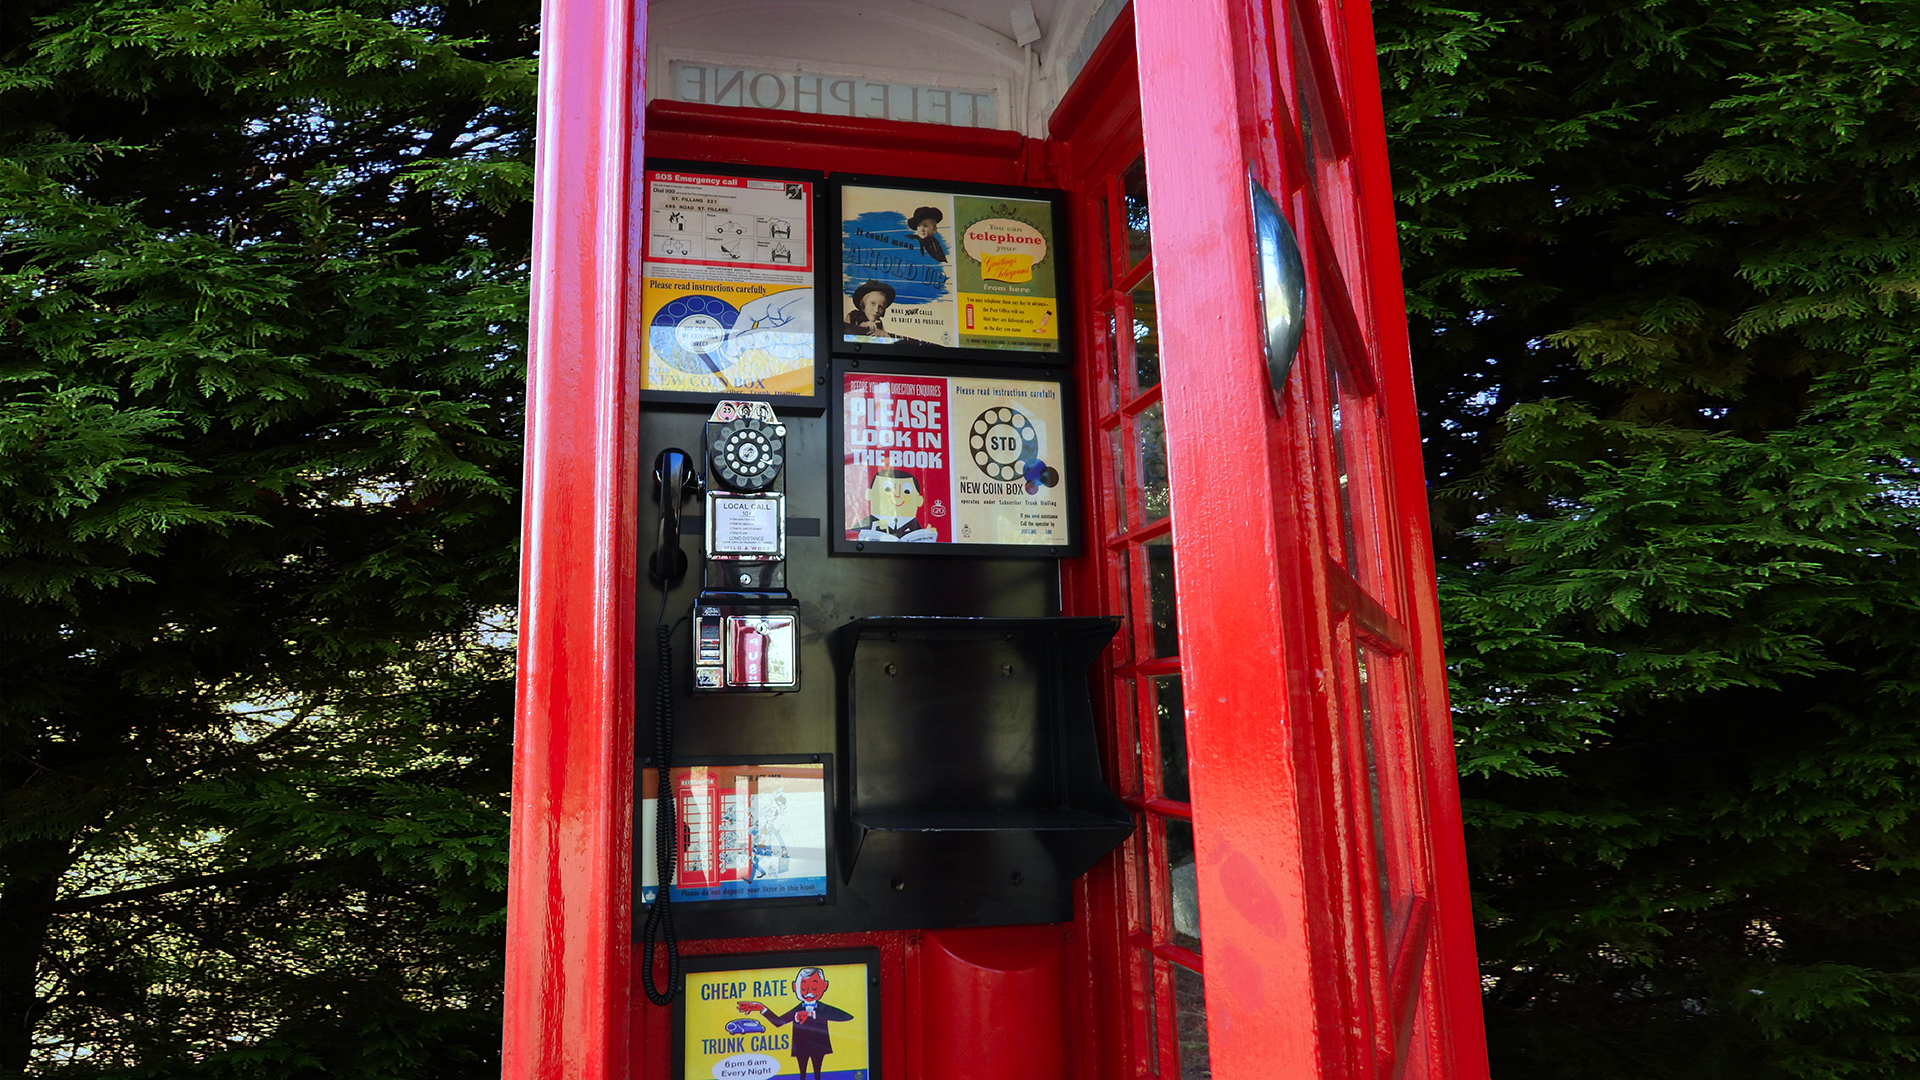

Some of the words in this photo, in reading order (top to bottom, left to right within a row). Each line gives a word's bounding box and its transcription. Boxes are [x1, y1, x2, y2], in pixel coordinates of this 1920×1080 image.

[675, 175, 720, 185] Emergency
[856, 227, 863, 236] It
[866, 231, 889, 243] could
[891, 239, 914, 250] mean
[969, 232, 1042, 245] telephone
[863, 247, 917, 280] HOLD
[982, 256, 1017, 273] Greetings
[993, 266, 1030, 280] Telegrams
[650, 280, 672, 290] Please
[674, 282, 690, 290] read
[692, 282, 734, 292] instructions
[736, 285, 766, 297] carefully
[983, 284, 1006, 292] from
[1009, 285, 1031, 293] here
[649, 374, 683, 386] NEW
[690, 376, 728, 387] COIN
[734, 377, 765, 389] BOX
[850, 380, 868, 393] BEFORE
[891, 383, 916, 395] DIRECTORY
[916, 384, 941, 397] ENQUIRIES
[956, 386, 975, 395] Please
[977, 387, 990, 396] read
[992, 387, 1027, 398] instructions
[1030, 390, 1055, 400] carefully
[850, 397, 941, 429] PLEASE
[851, 428, 911, 447] LOOK
[917, 432, 942, 449] IN
[990, 436, 1017, 451] STD
[851, 448, 885, 466] THE
[889, 450, 942, 469] BOOK
[960, 482, 980, 494] NEW
[982, 482, 1003, 495] COIN
[1006, 483, 1024, 495] BOX
[682, 889, 699, 897] Please
[723, 887, 744, 896] deposit
[701, 982, 746, 1001] CHEAP
[753, 980, 788, 998] RATE
[702, 1037, 745, 1055] TRUNK
[751, 1034, 789, 1052] CALLS
[721, 1067, 746, 1078] Every
[748, 1067, 772, 1077] Night
